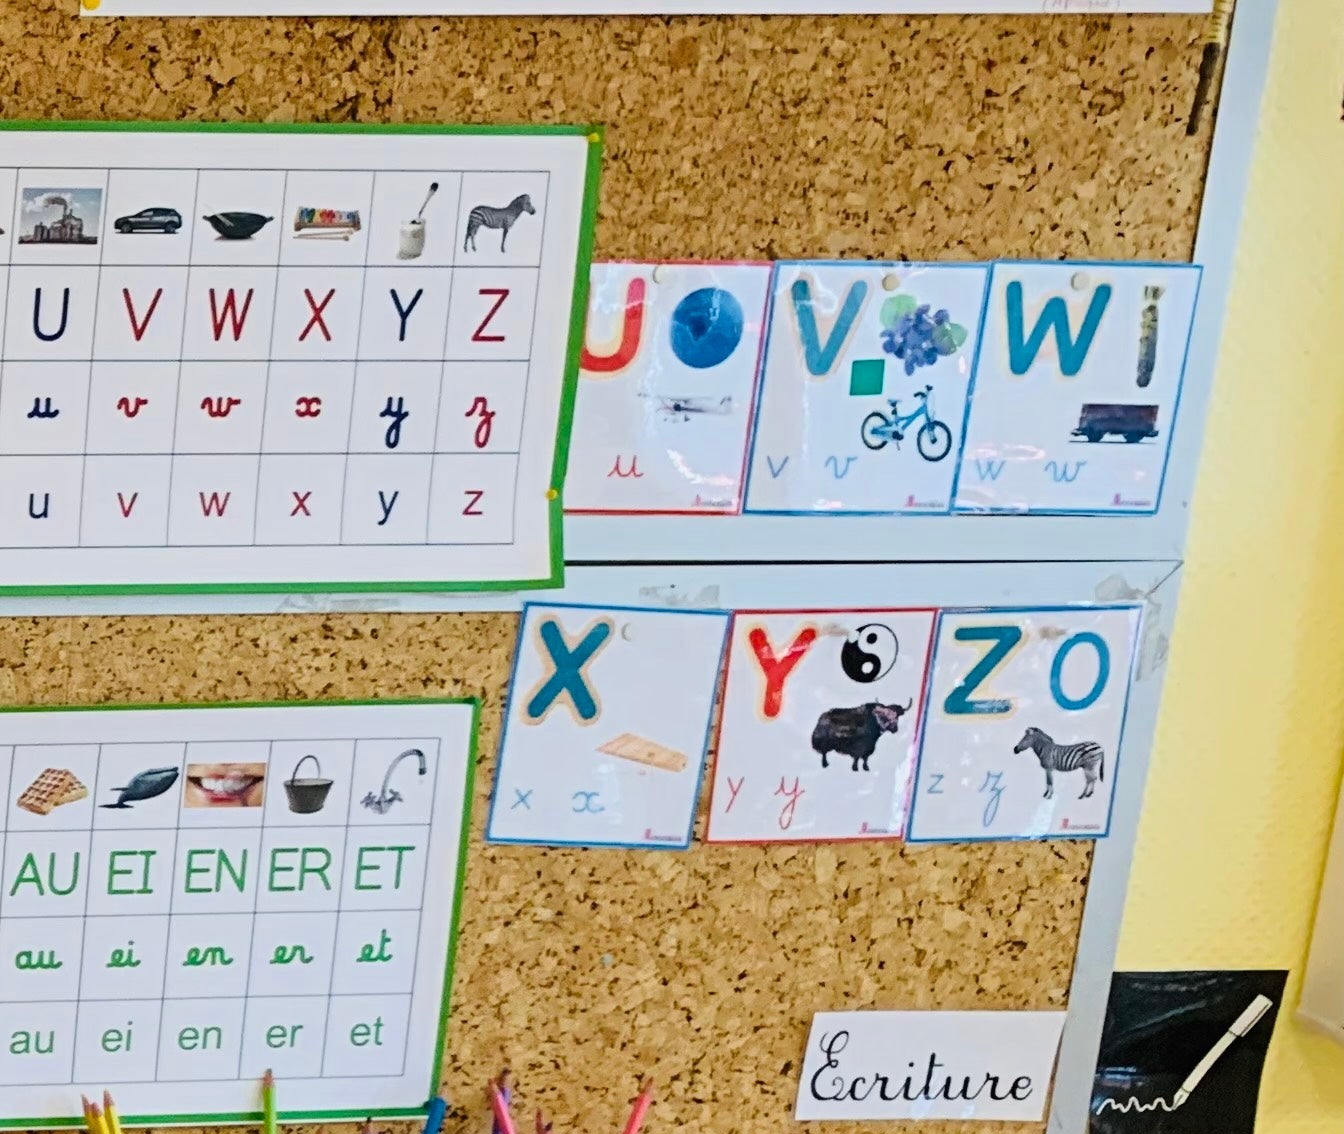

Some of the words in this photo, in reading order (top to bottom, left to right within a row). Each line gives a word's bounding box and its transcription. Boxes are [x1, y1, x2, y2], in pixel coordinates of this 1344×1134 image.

[32, 287, 71, 343] U
[121, 287, 164, 342] V
[208, 287, 255, 342] W
[297, 287, 336, 343] X
[389, 287, 424, 343] Y
[470, 287, 511, 343] Z
[792, 279, 868, 376] V
[1005, 279, 1113, 377] W
[527, 620, 610, 720] X
[749, 628, 817, 718] Y
[944, 626, 1023, 715] Z
[9, 851, 81, 897] AU
[106, 849, 158, 896] EI
[184, 848, 249, 894] EN
[267, 846, 332, 893] ER
[353, 845, 417, 891] ET
[14, 949, 64, 971] au
[105, 939, 142, 969] ei
[181, 945, 235, 967] en
[269, 944, 315, 965] er
[355, 928, 394, 963] et
[9, 1030, 55, 1055] au
[101, 1020, 133, 1053] ei
[177, 1026, 222, 1051] en
[265, 1024, 304, 1049] er
[349, 1015, 384, 1047] et
[810, 1030, 1034, 1102] Ecriture
